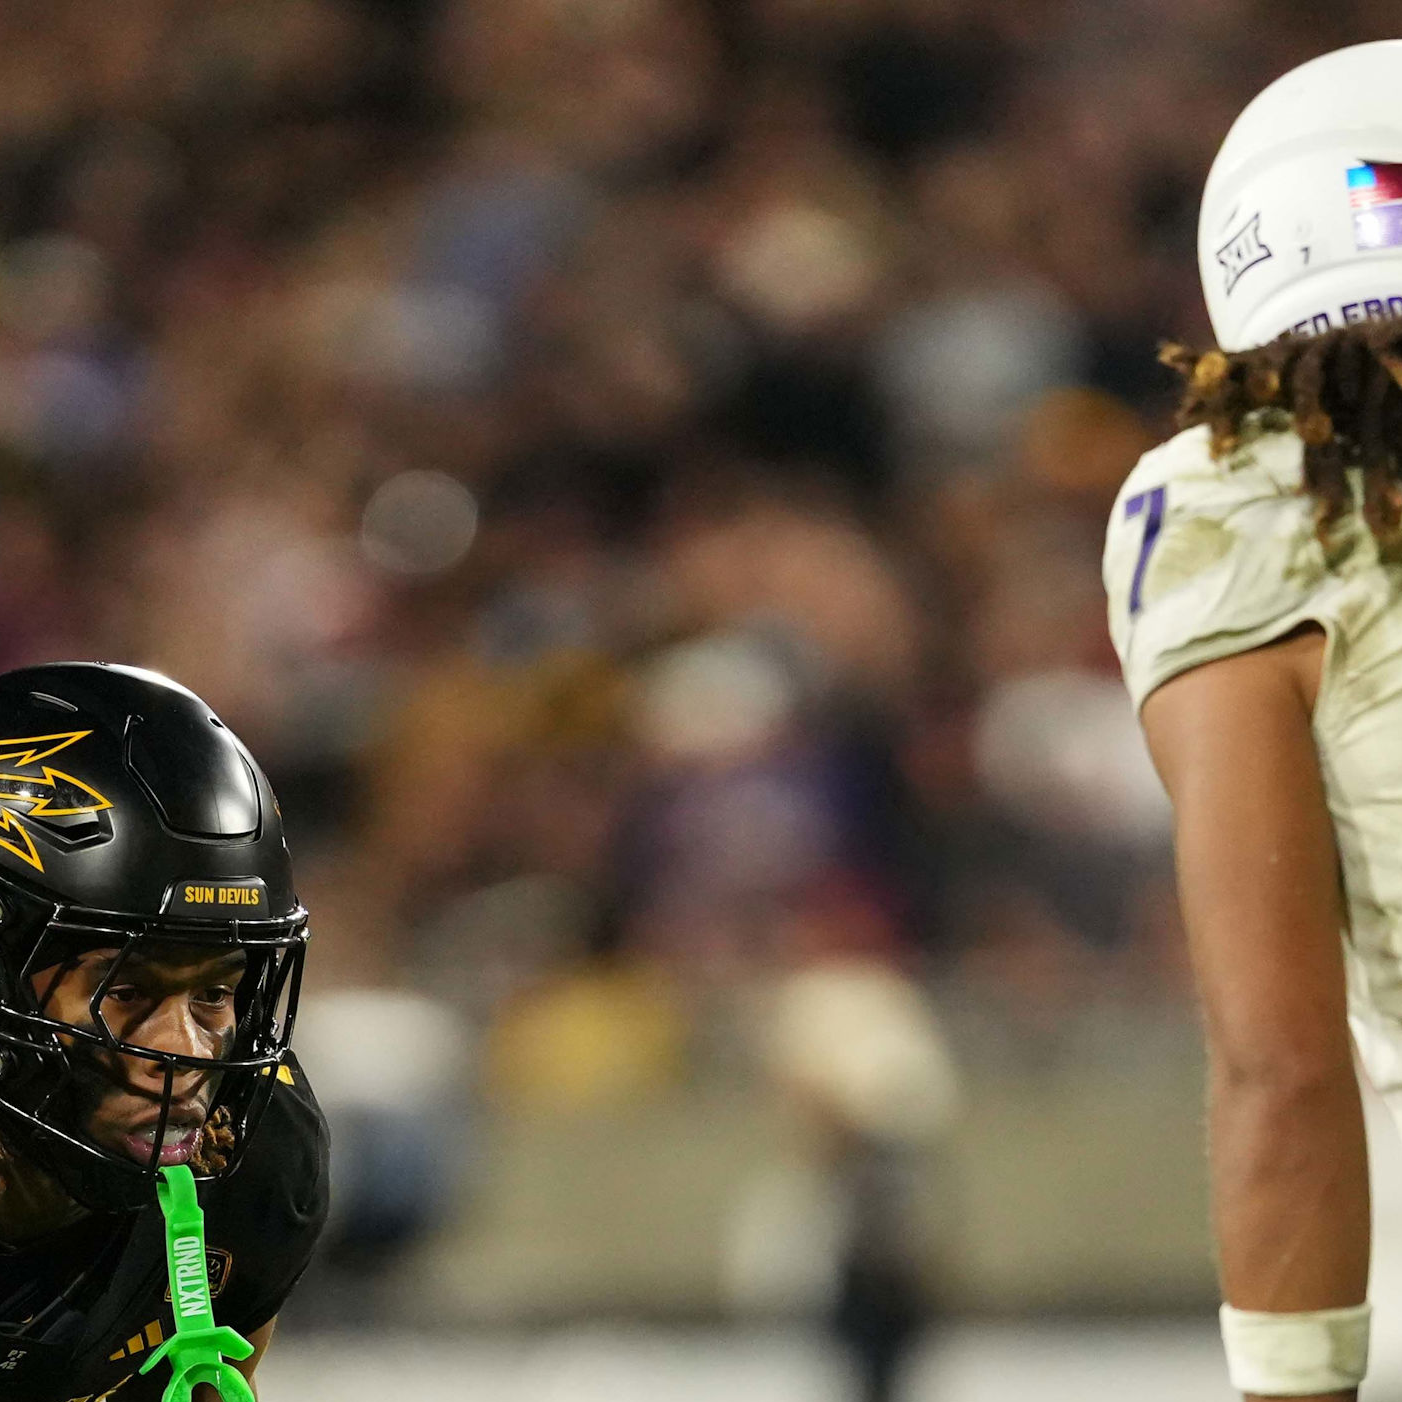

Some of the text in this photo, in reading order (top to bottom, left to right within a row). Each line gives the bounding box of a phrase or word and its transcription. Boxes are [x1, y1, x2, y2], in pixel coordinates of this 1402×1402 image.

[1299, 246, 1310, 265] 7
[1125, 487, 1166, 614] 7
[184, 885, 260, 905] SUN DEVILS
[173, 1235, 209, 1317] NXTRND
